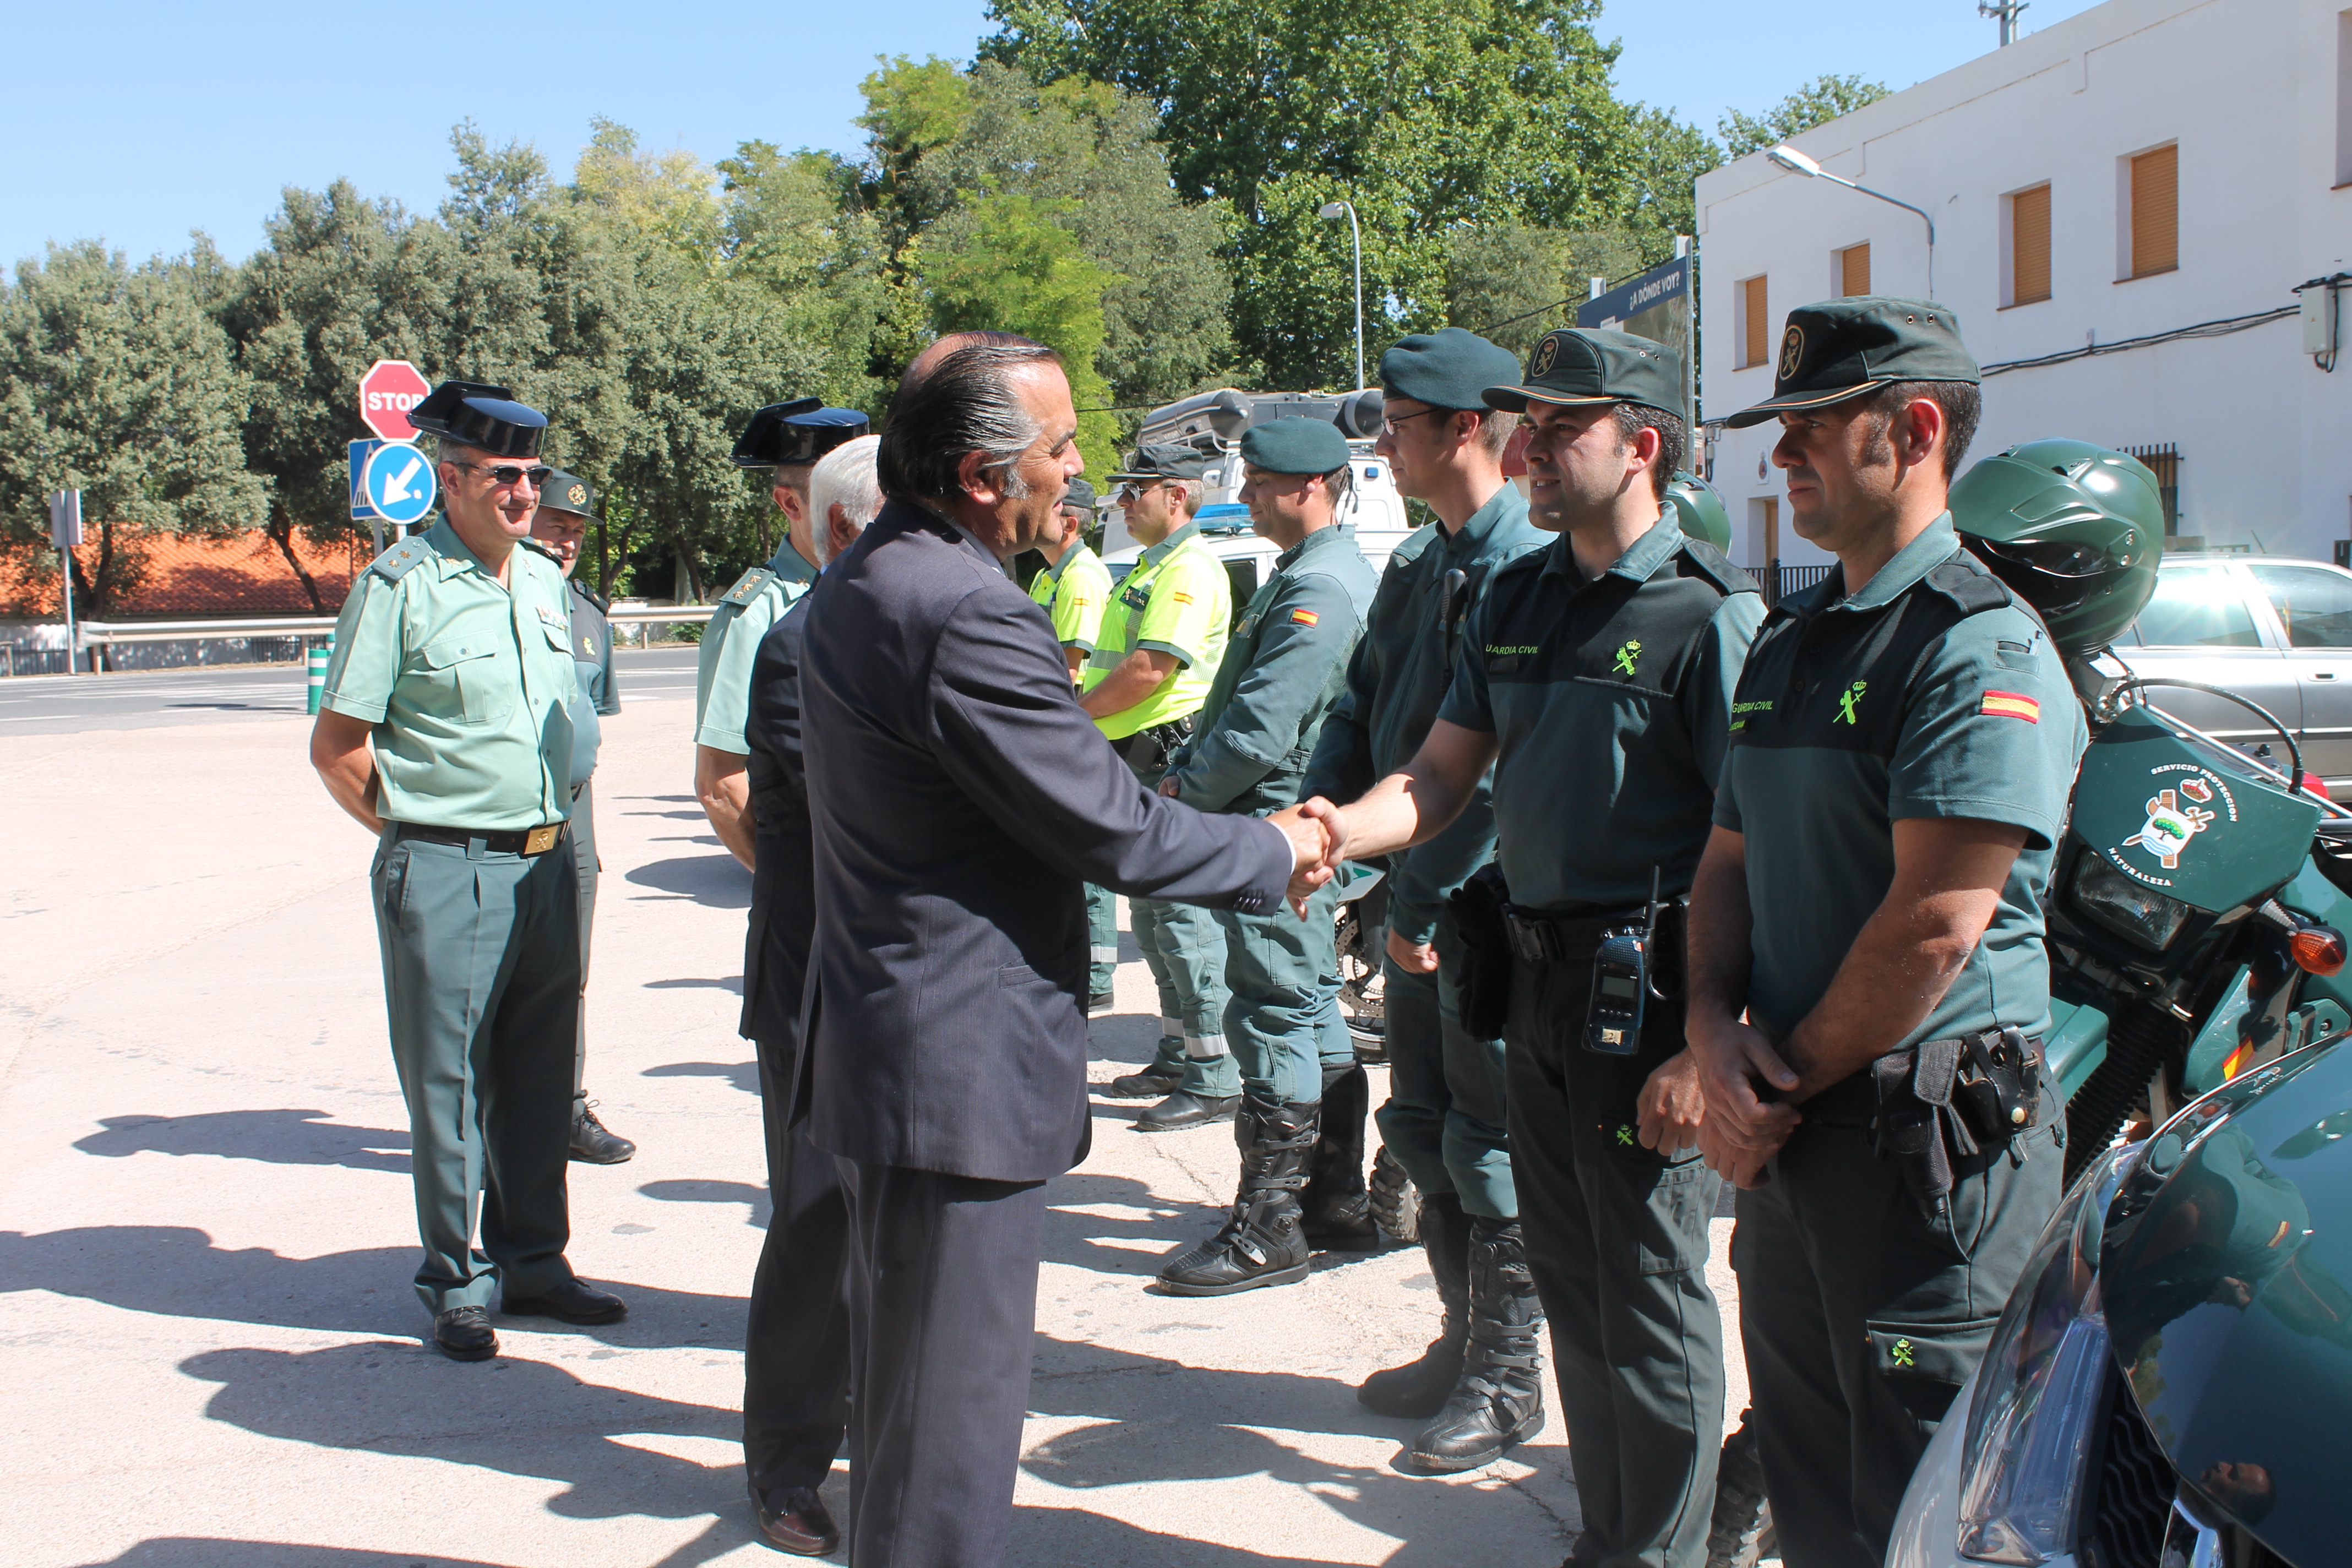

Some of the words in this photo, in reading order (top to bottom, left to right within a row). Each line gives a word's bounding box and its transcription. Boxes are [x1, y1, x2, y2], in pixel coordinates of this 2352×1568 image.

[1630, 291, 1638, 311] ¿A
[1638, 280, 1660, 304] DÓNDE
[1661, 271, 1680, 292] VOY?
[1485, 644, 1516, 654] UARDIA
[1518, 646, 1538, 654] CIVIL
[1754, 700, 1773, 710] CIVIL
[2149, 764, 2199, 775] SERVICIO
[2198, 768, 2239, 822] PROTECCION
[2107, 846, 2173, 887] NATURALEZA
